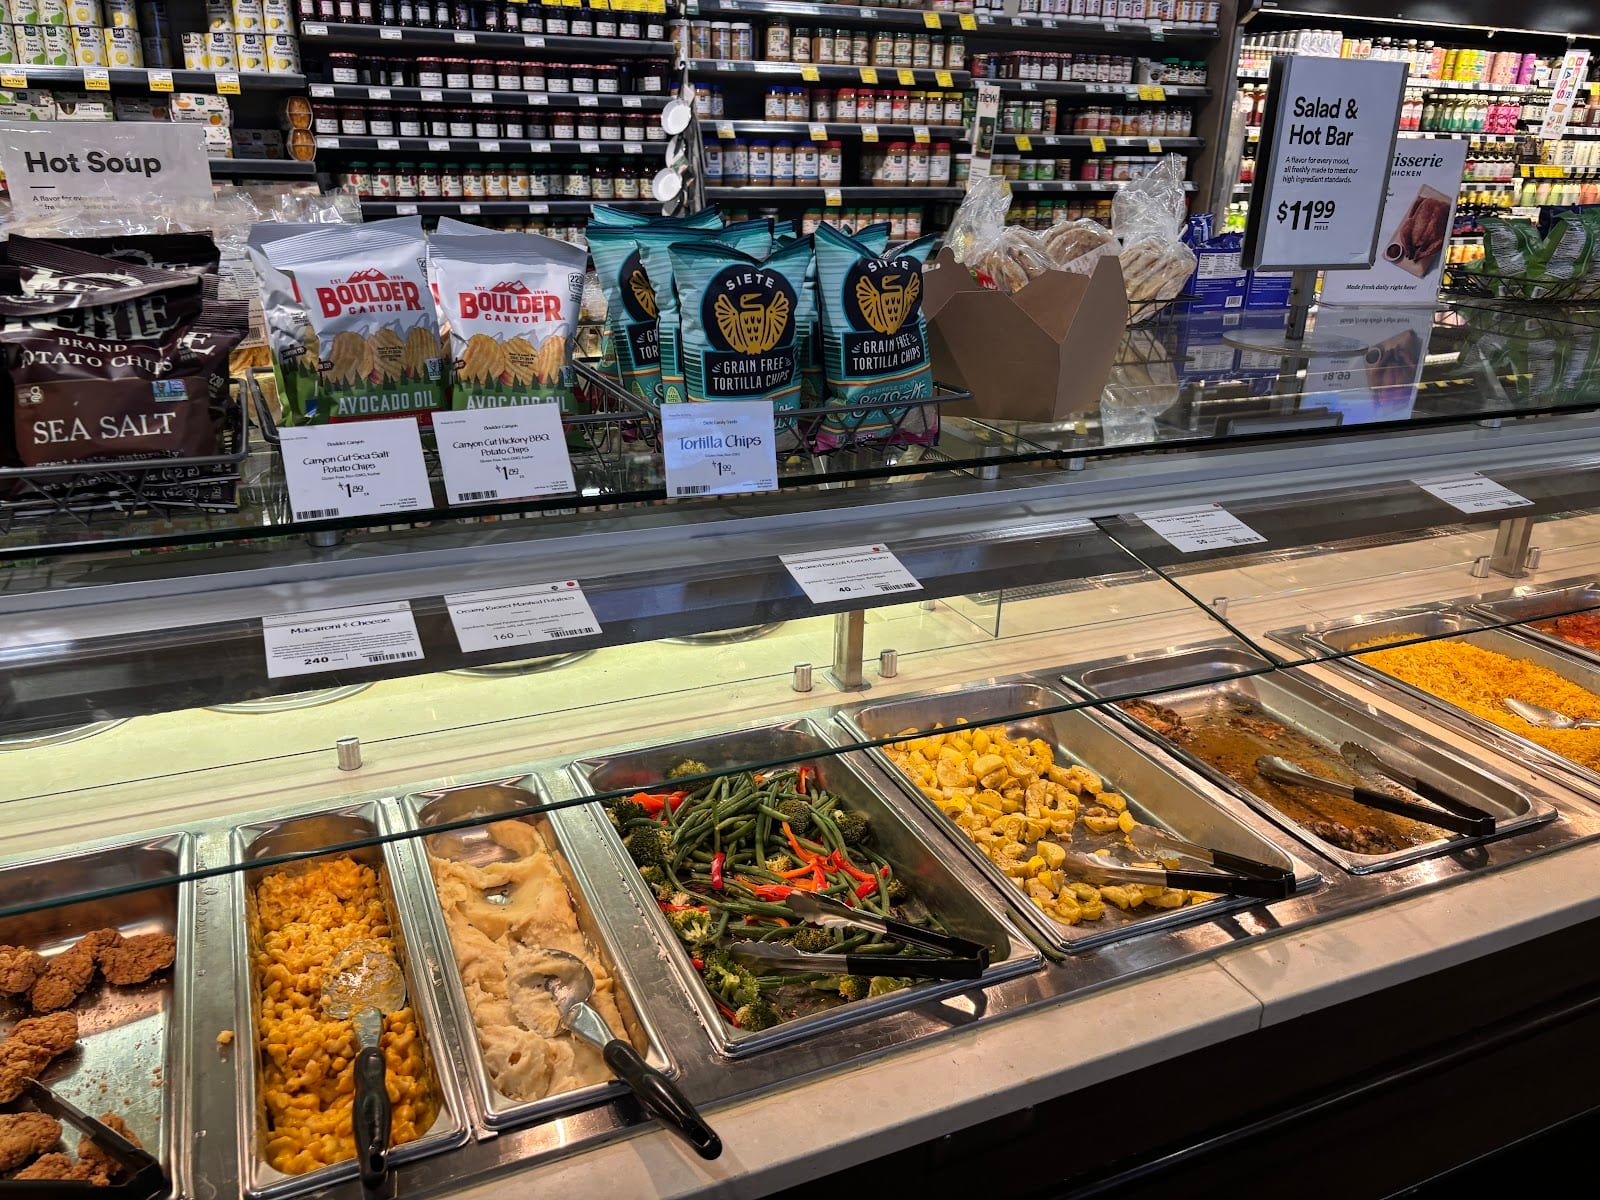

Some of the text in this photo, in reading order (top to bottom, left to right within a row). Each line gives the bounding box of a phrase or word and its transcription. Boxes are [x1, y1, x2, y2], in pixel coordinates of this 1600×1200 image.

[1293, 96, 1358, 120] Salad &
[1289, 124, 1354, 146] Hot Bar
[24, 151, 162, 178] Hot Soup
[1292, 166, 1310, 174] freshly
[1311, 166, 1326, 174] made
[1328, 166, 1334, 174] to
[1282, 175, 1294, 184] high
[1296, 176, 1324, 184] ingredient
[726, 274, 774, 290] SIETE
[316, 281, 422, 318] BOULDER
[458, 292, 562, 322] BOULDER
[348, 304, 402, 314] CANYON
[484, 313, 538, 324] CANYON
[58, 337, 128, 352] BRAND
[863, 333, 911, 354] GRAIN FREE
[22, 350, 173, 375] OTATO CHIPS
[724, 356, 784, 374] GRAIN FREE
[852, 346, 920, 371] TORTILLA CHIPS
[712, 370, 790, 391] TORTILLA CHIPS
[338, 390, 438, 415] AVOCADO OIL
[33, 412, 176, 444] SEA SALT
[452, 441, 484, 450] Canyon
[498, 436, 528, 446] Hickory
[529, 434, 550, 444] BBQ
[678, 434, 762, 450] Tortilla Chips
[480, 446, 530, 456] Potato Chips
[302, 456, 336, 466] Canyon
[337, 454, 352, 463] Cut
[351, 453, 370, 461] Sea
[322, 463, 376, 474] Potato Chips
[290, 624, 341, 634] Macaroni
[350, 618, 391, 627] Cheese
[493, 632, 514, 640] 160
[304, 656, 329, 665] 240
